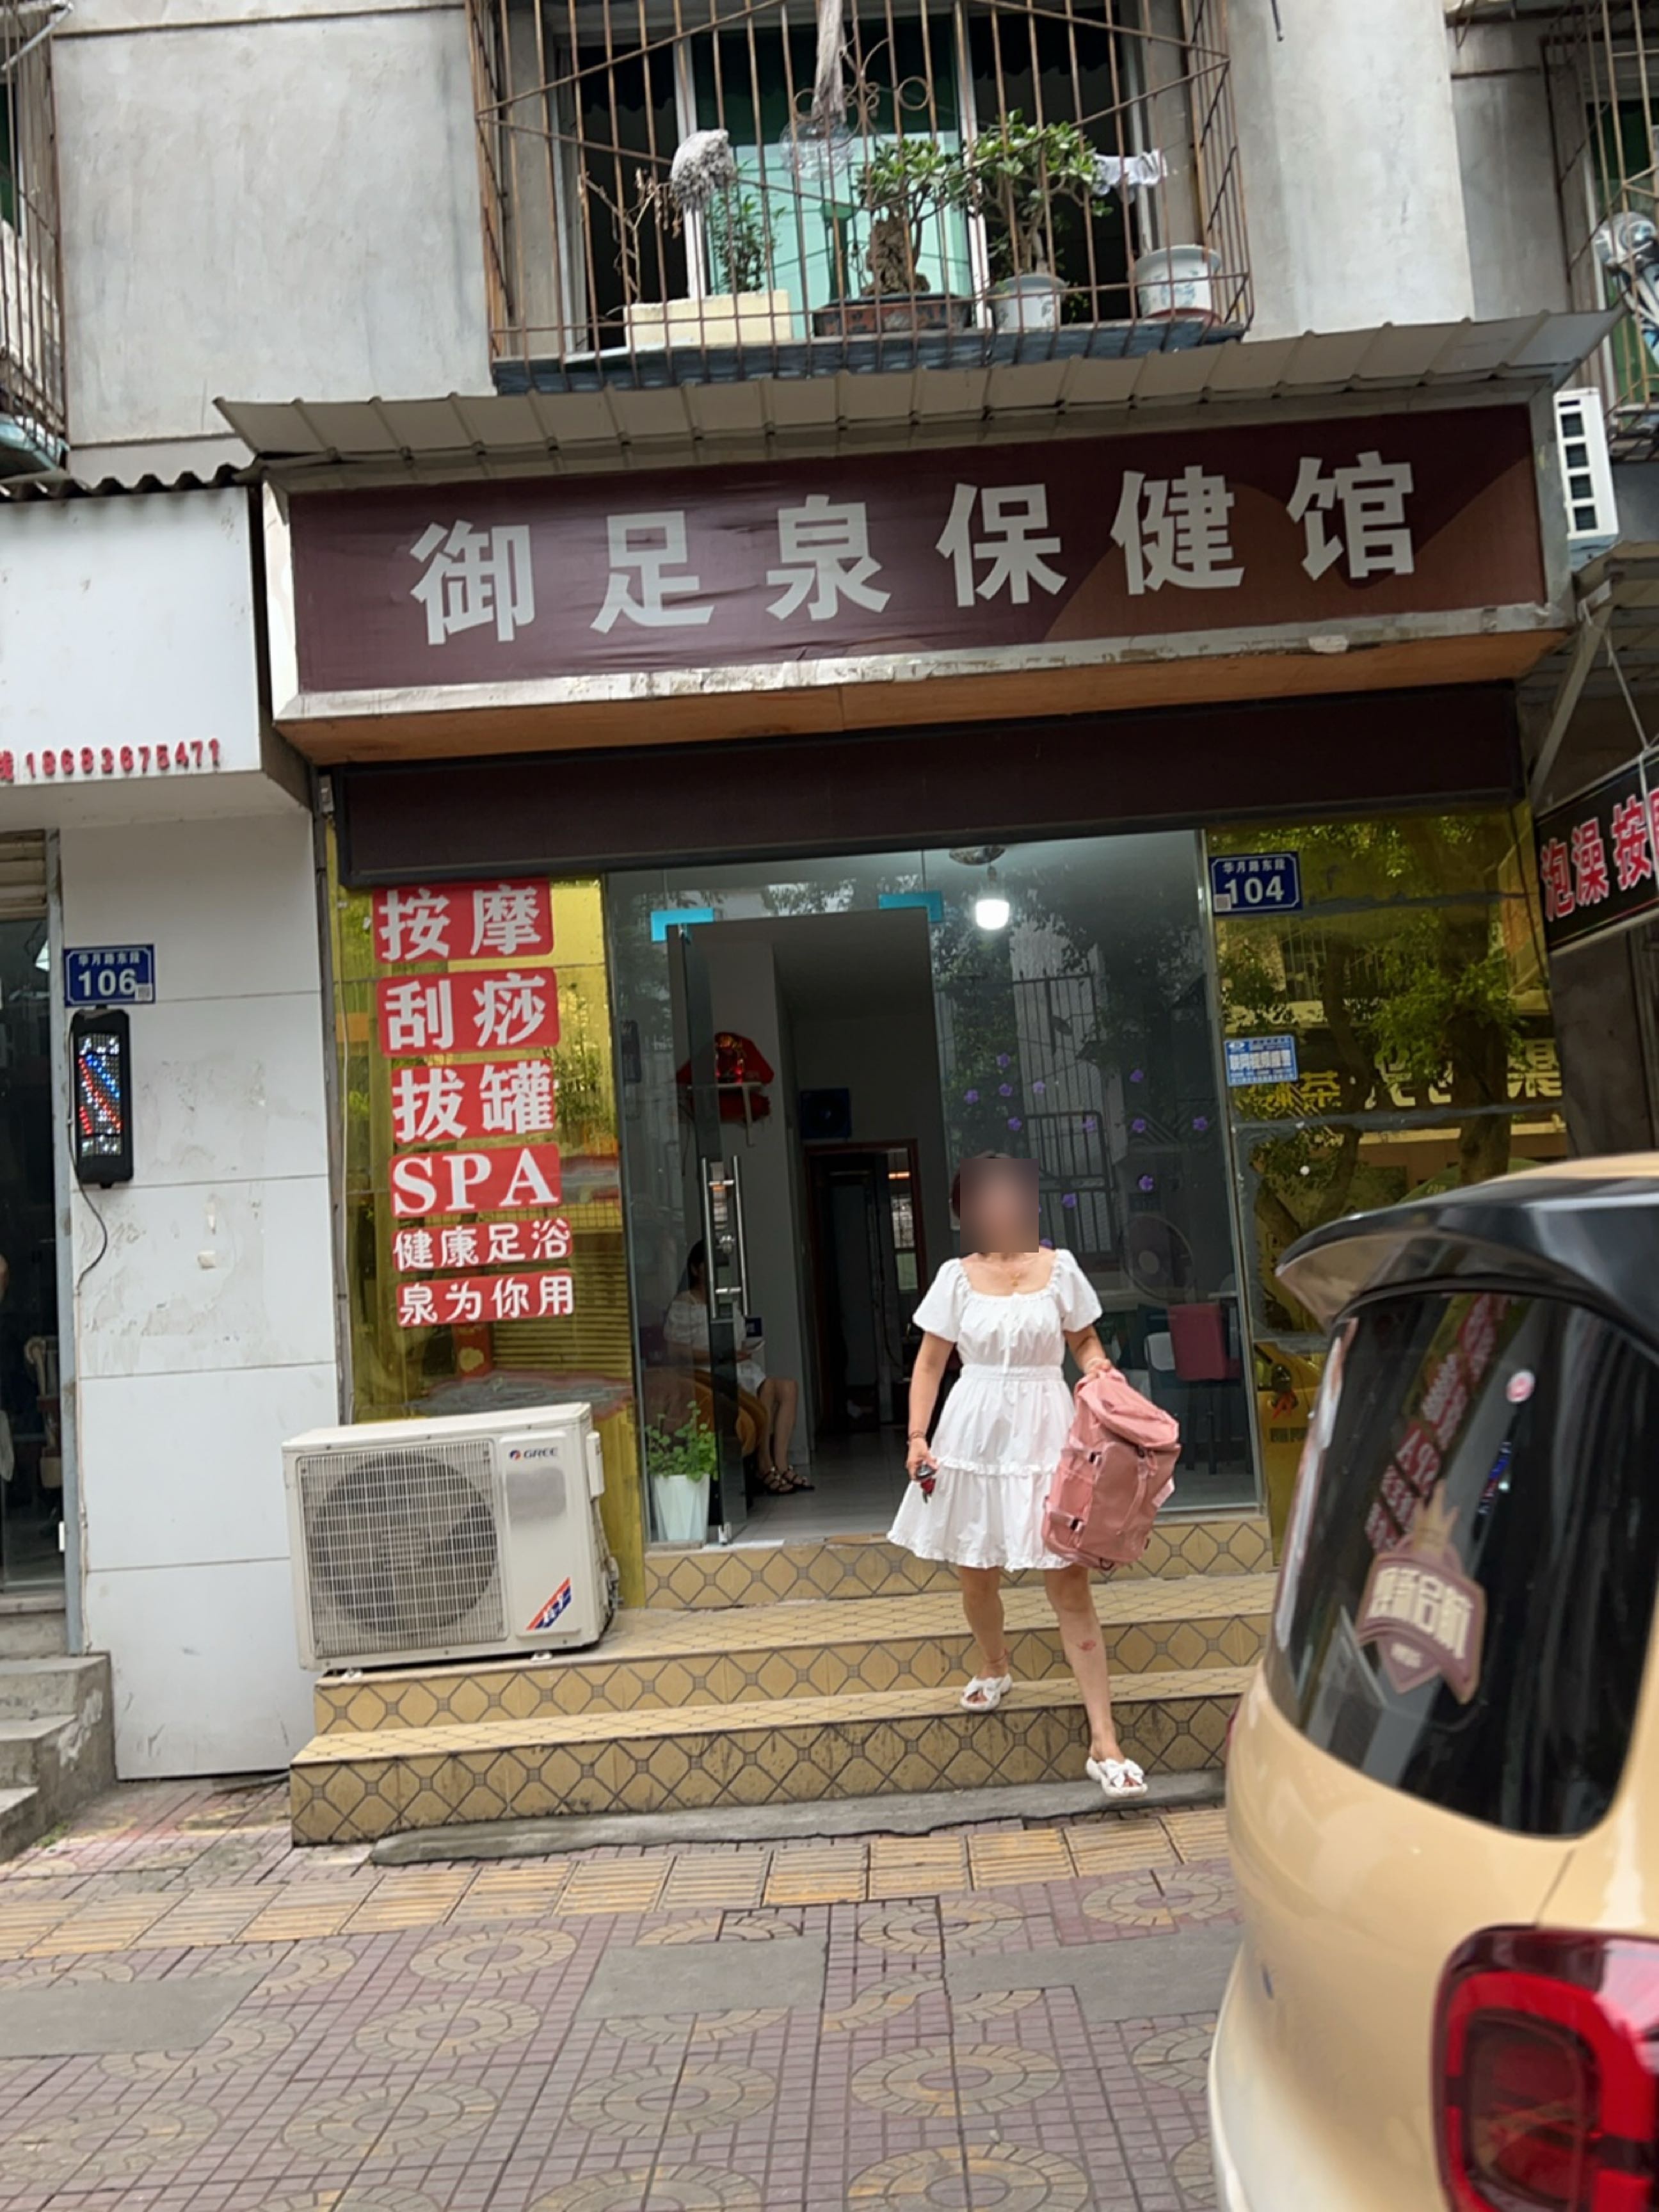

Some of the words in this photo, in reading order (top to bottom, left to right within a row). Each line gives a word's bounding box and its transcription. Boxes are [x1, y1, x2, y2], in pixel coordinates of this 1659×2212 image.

[408, 451, 1416, 646] 御足泉保健馆
[1224, 875, 1285, 904] 104
[1541, 789, 1659, 922] 泡澡按
[379, 884, 541, 961] 按摩
[78, 968, 137, 997] 106
[385, 972, 547, 1051] 刮痧
[392, 1061, 554, 1142] 拔罐
[392, 1148, 558, 1216] SPA
[392, 1218, 571, 1272] 健康足浴
[399, 1275, 574, 1326] 泉为你用
